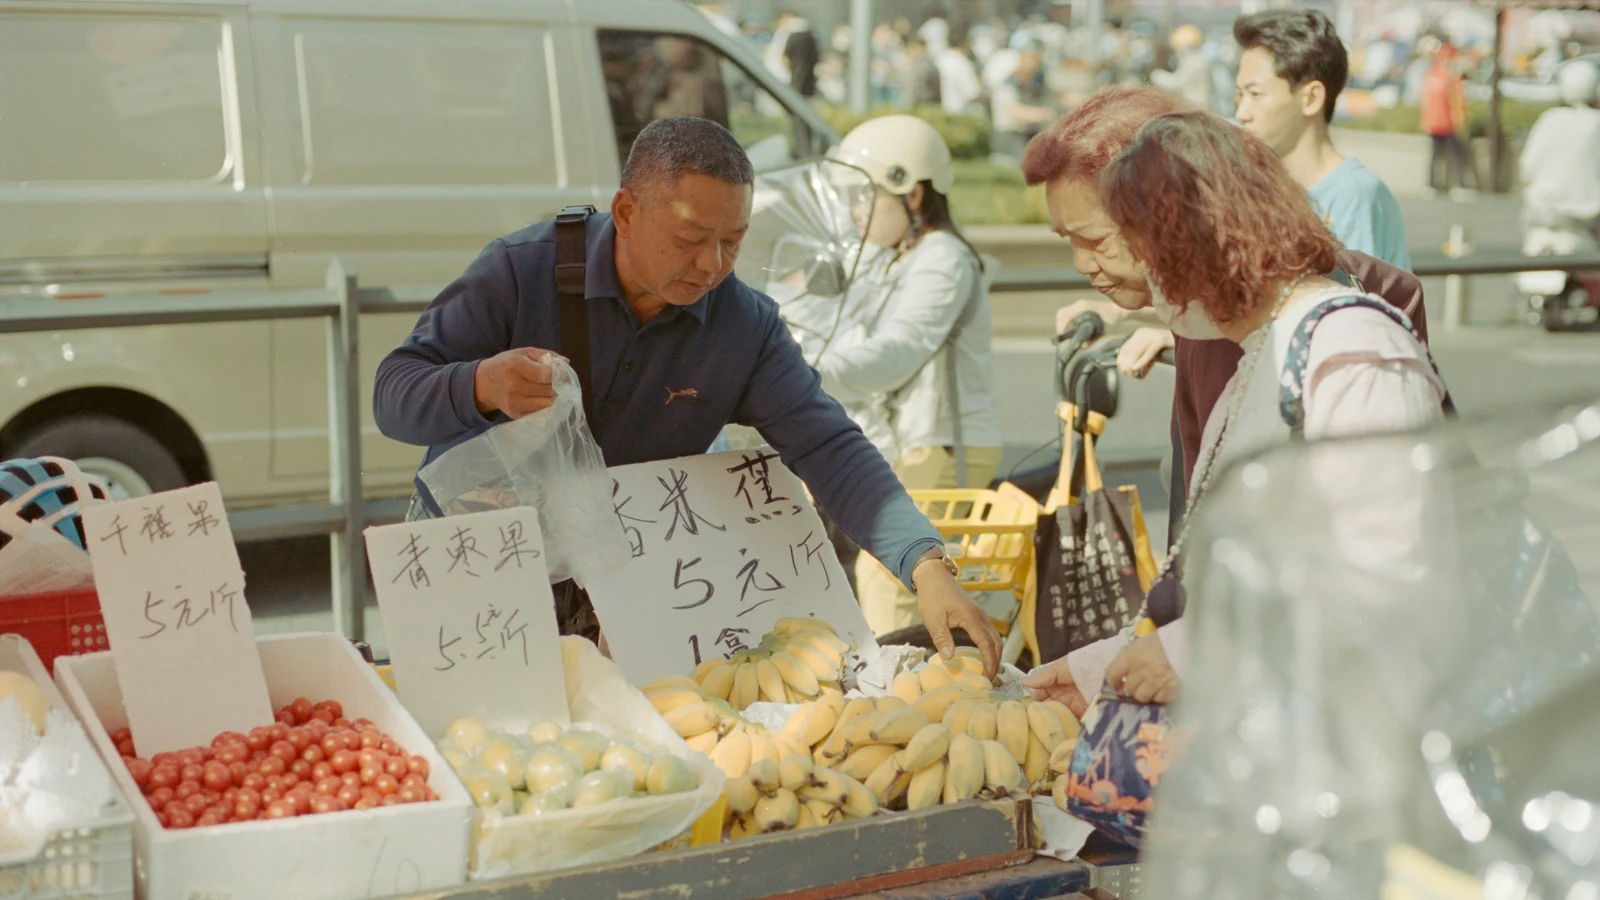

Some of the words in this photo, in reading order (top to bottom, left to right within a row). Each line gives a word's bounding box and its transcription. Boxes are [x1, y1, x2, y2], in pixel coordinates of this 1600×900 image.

[101, 501, 220, 556] 千禧果
[392, 520, 540, 589] 青枣果
